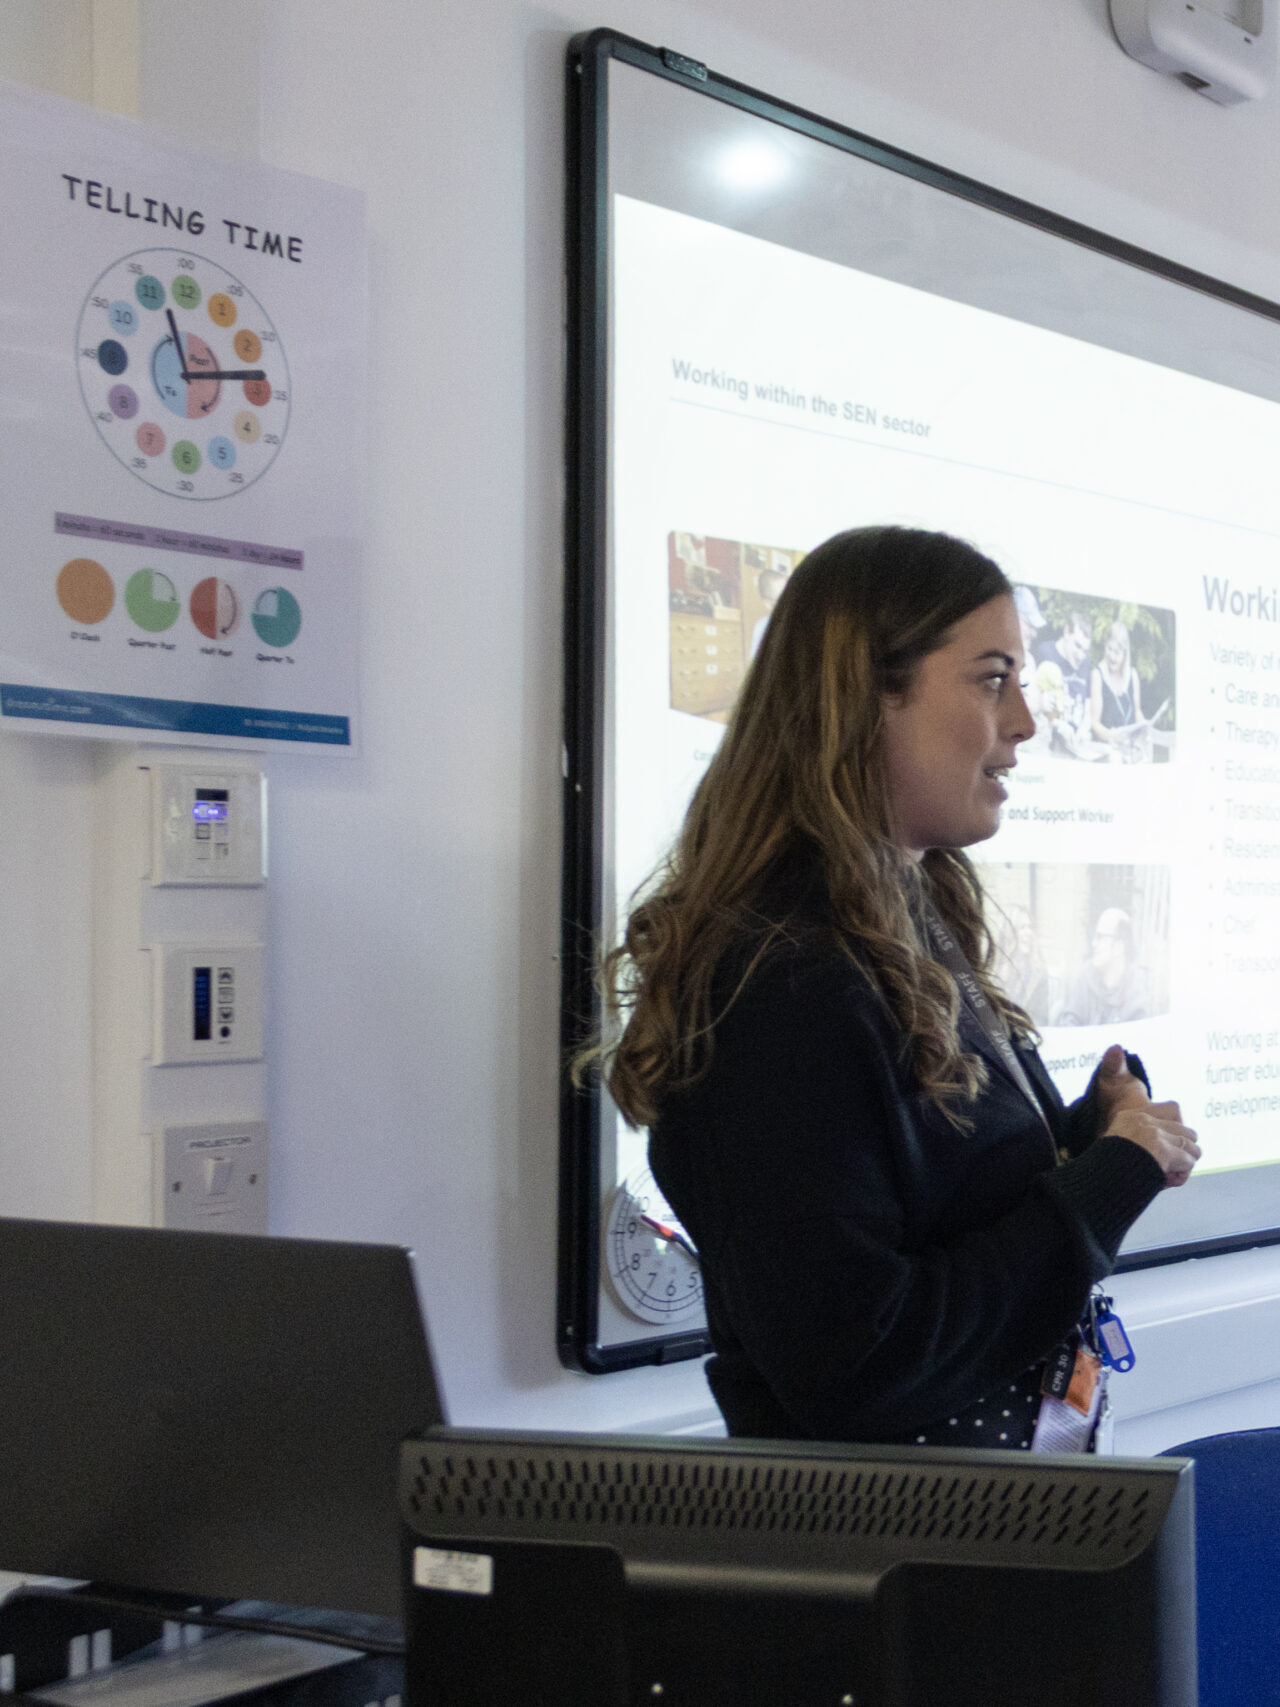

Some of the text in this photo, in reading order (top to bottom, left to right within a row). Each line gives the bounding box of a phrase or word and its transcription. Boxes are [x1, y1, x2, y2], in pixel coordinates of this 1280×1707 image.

[62, 173, 304, 264] TELLING TIME
[114, 310, 134, 325] 10
[672, 356, 932, 438] Working within the SEN sector
[218, 446, 228, 460] 5
[1210, 642, 1257, 672] Variety
[1261, 651, 1274, 670] of
[1225, 683, 1258, 706] Care
[1225, 721, 1280, 751] Therapy
[1008, 806, 1029, 820] and
[1033, 805, 1074, 824] Support
[1078, 808, 1115, 823] Worker
[956, 972, 986, 1008] STAFF
[1206, 1030, 1263, 1053] Working
[1266, 1030, 1279, 1047] at
[1205, 1064, 1252, 1085] further
[628, 1221, 638, 1240] 9
[631, 1252, 641, 1271] 8
[647, 1272, 657, 1289] 7
[665, 1279, 677, 1297] 6
[688, 1271, 699, 1289] 5
[1052, 1371, 1065, 1392] CPR
